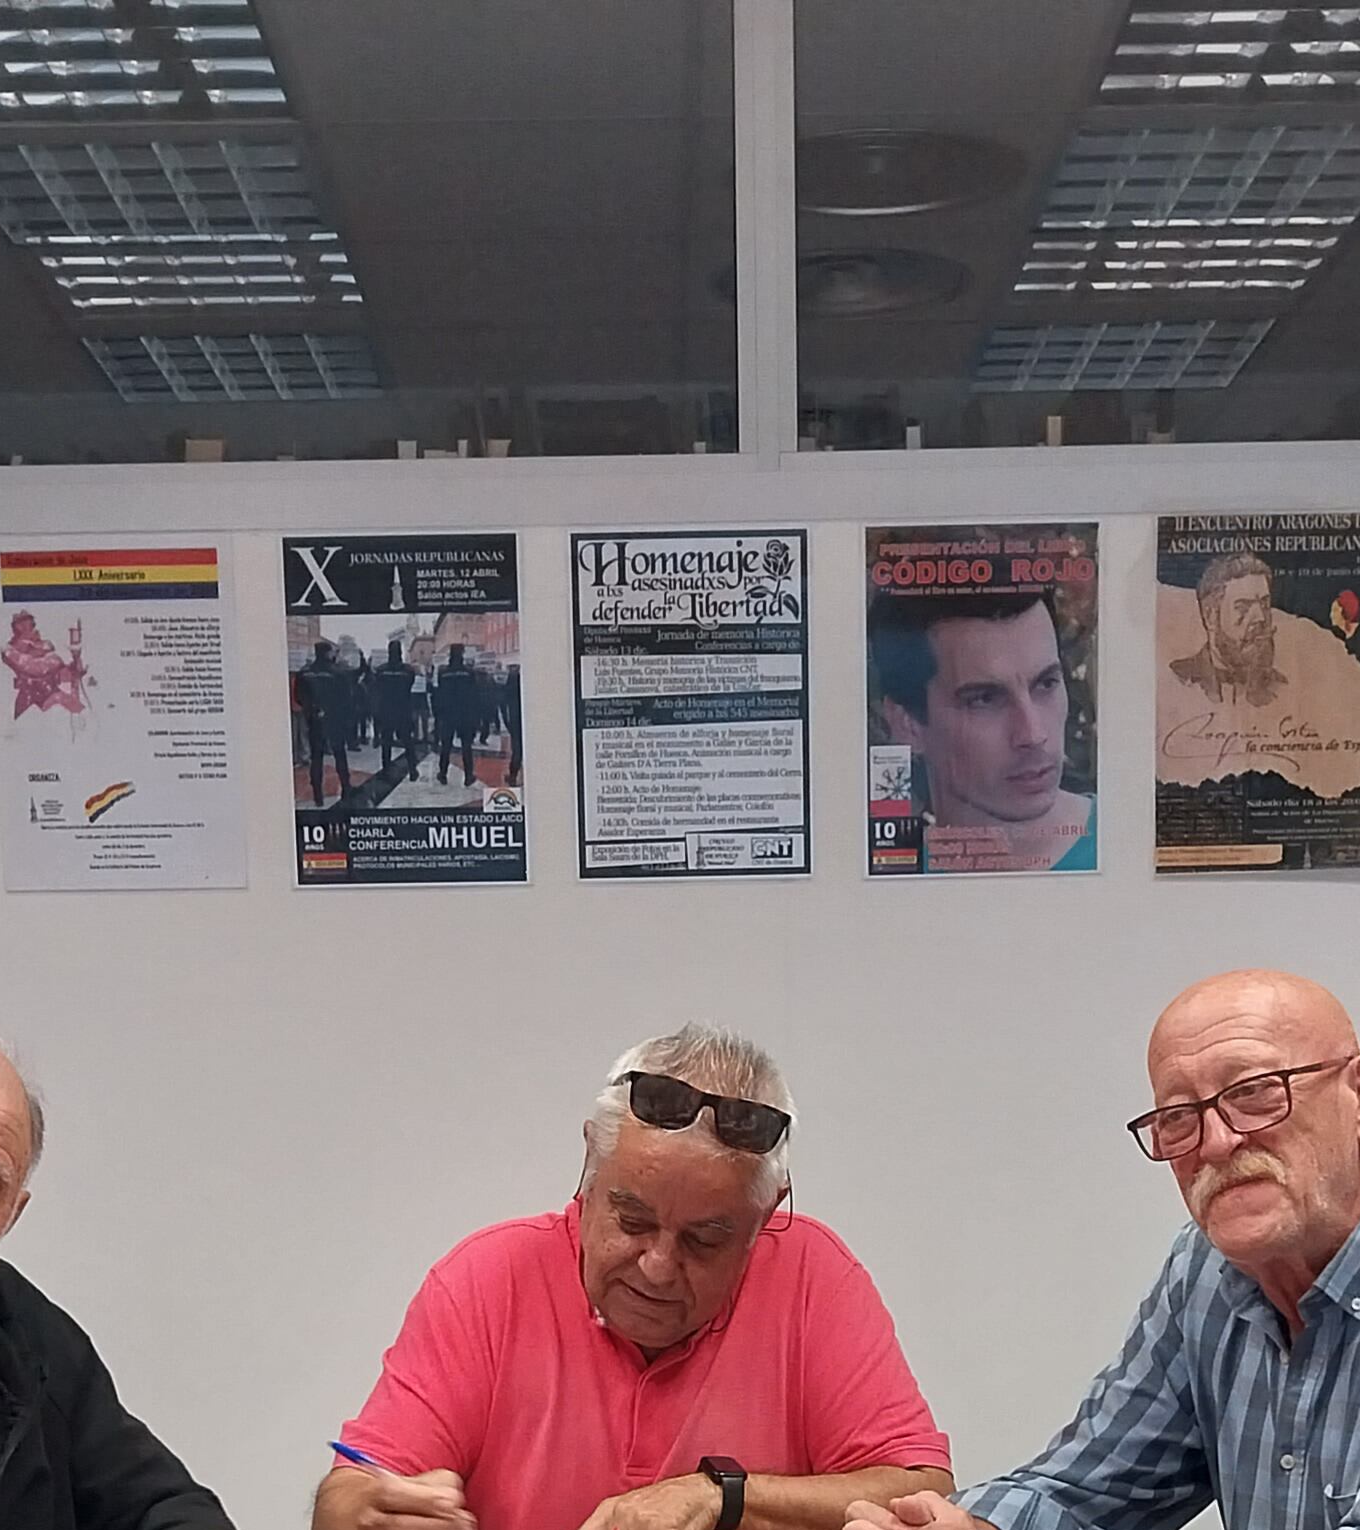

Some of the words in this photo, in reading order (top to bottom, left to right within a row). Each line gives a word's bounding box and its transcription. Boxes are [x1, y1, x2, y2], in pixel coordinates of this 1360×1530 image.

[1189, 514, 1272, 531] ENCUENTRO
[1168, 536, 1271, 553] ASOCIACIONES
[350, 552, 413, 566] JORNADAS
[415, 551, 504, 562] REPUBLICANAS
[580, 540, 759, 588] Homenaje
[98, 569, 145, 581] Aniversario
[291, 546, 348, 606] X
[460, 569, 470, 577] 12
[472, 568, 500, 577] ABRIL
[872, 556, 992, 585] CÓDIGO
[1011, 558, 1095, 582] ROJO
[443, 580, 476, 588] HORAS
[631, 572, 725, 592] asesinadxs
[744, 576, 762, 591] por
[444, 591, 468, 599] actos
[592, 600, 672, 631] defender
[664, 591, 676, 606] la
[1246, 740, 1257, 752] la
[1326, 739, 1340, 750] de
[350, 815, 409, 825] MOVIMIENTO
[411, 815, 439, 824] HACIA
[442, 815, 454, 824] UN
[456, 814, 493, 824] ESTADO
[496, 813, 523, 823] LAICO
[303, 826, 325, 844] 10
[348, 828, 395, 838] CHARLA
[428, 826, 523, 849] MHUEL
[874, 822, 896, 840] 10
[349, 839, 428, 851] CONFERENCIA
[751, 838, 792, 858] CNT
